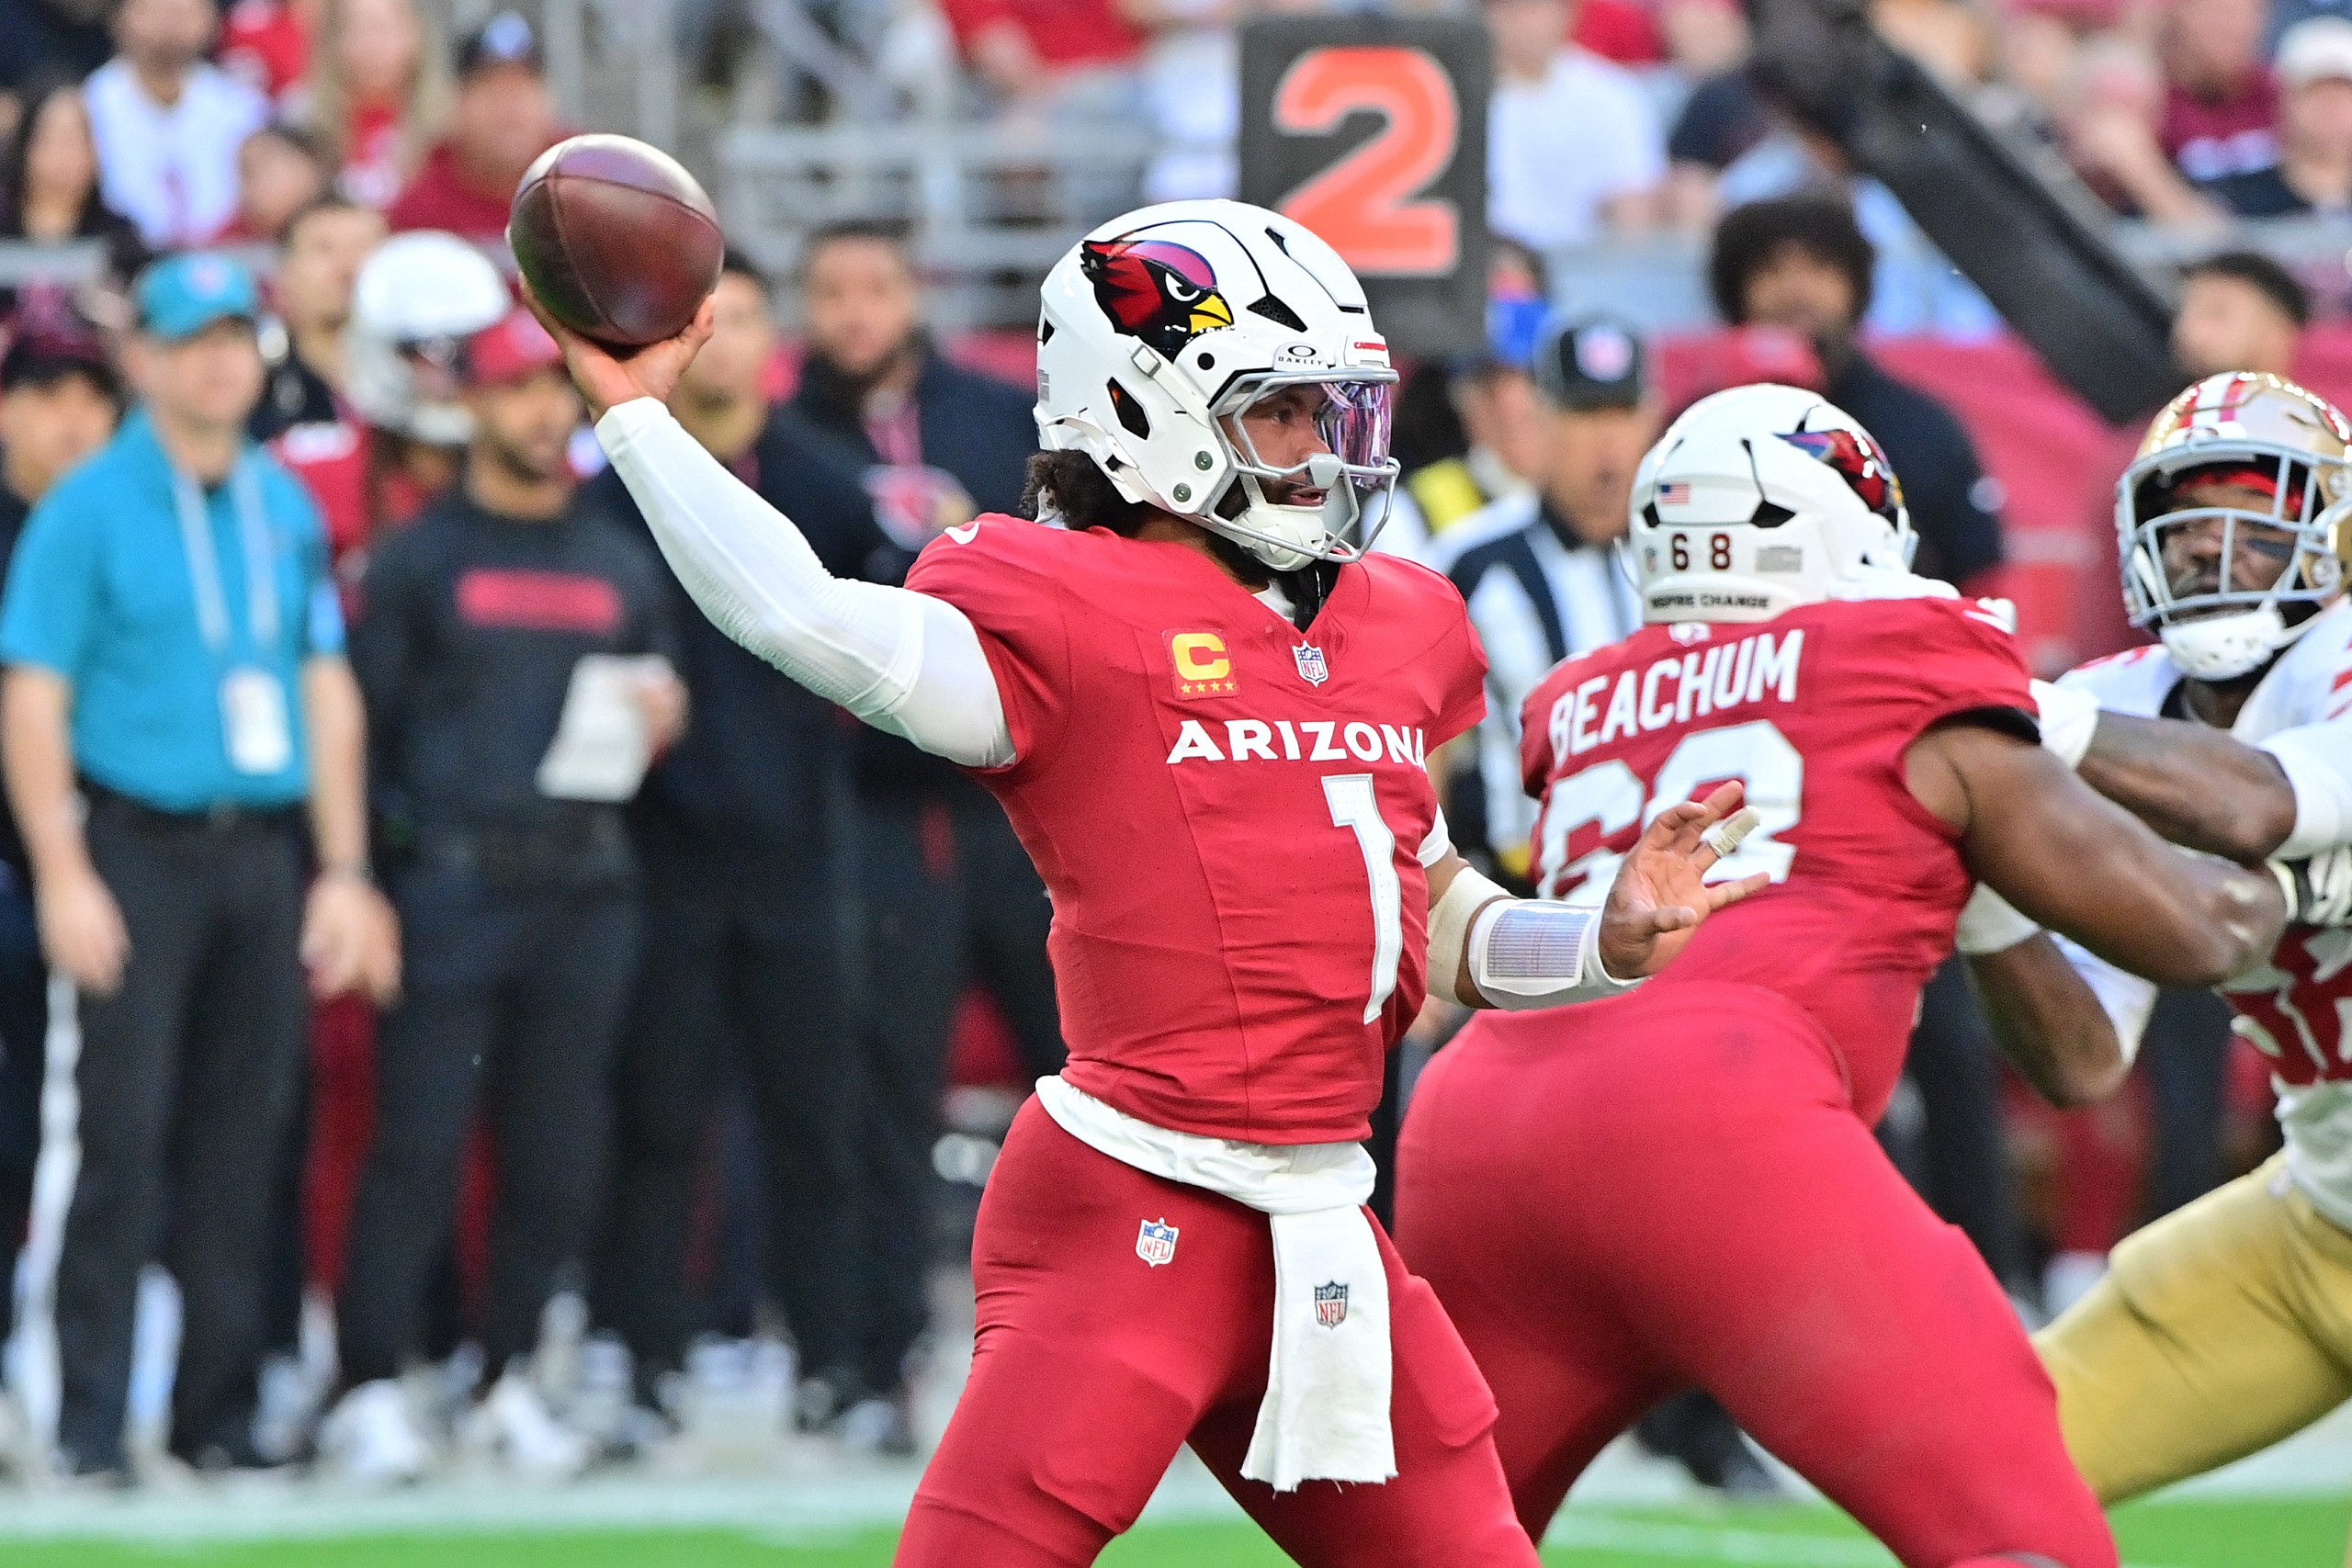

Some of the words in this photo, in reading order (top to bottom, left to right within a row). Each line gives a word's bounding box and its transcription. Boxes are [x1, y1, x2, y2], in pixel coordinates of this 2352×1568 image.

[1272, 45, 1461, 275] 2
[1278, 355, 1323, 366] OAKLEY
[1171, 632, 1230, 681] C
[1302, 660, 1324, 678] NFL
[1548, 629, 1804, 769] BEACHUM
[1321, 773, 1403, 1025] 1
[1143, 1239, 1168, 1258] NFL
[1318, 1302, 1344, 1324] NFL
